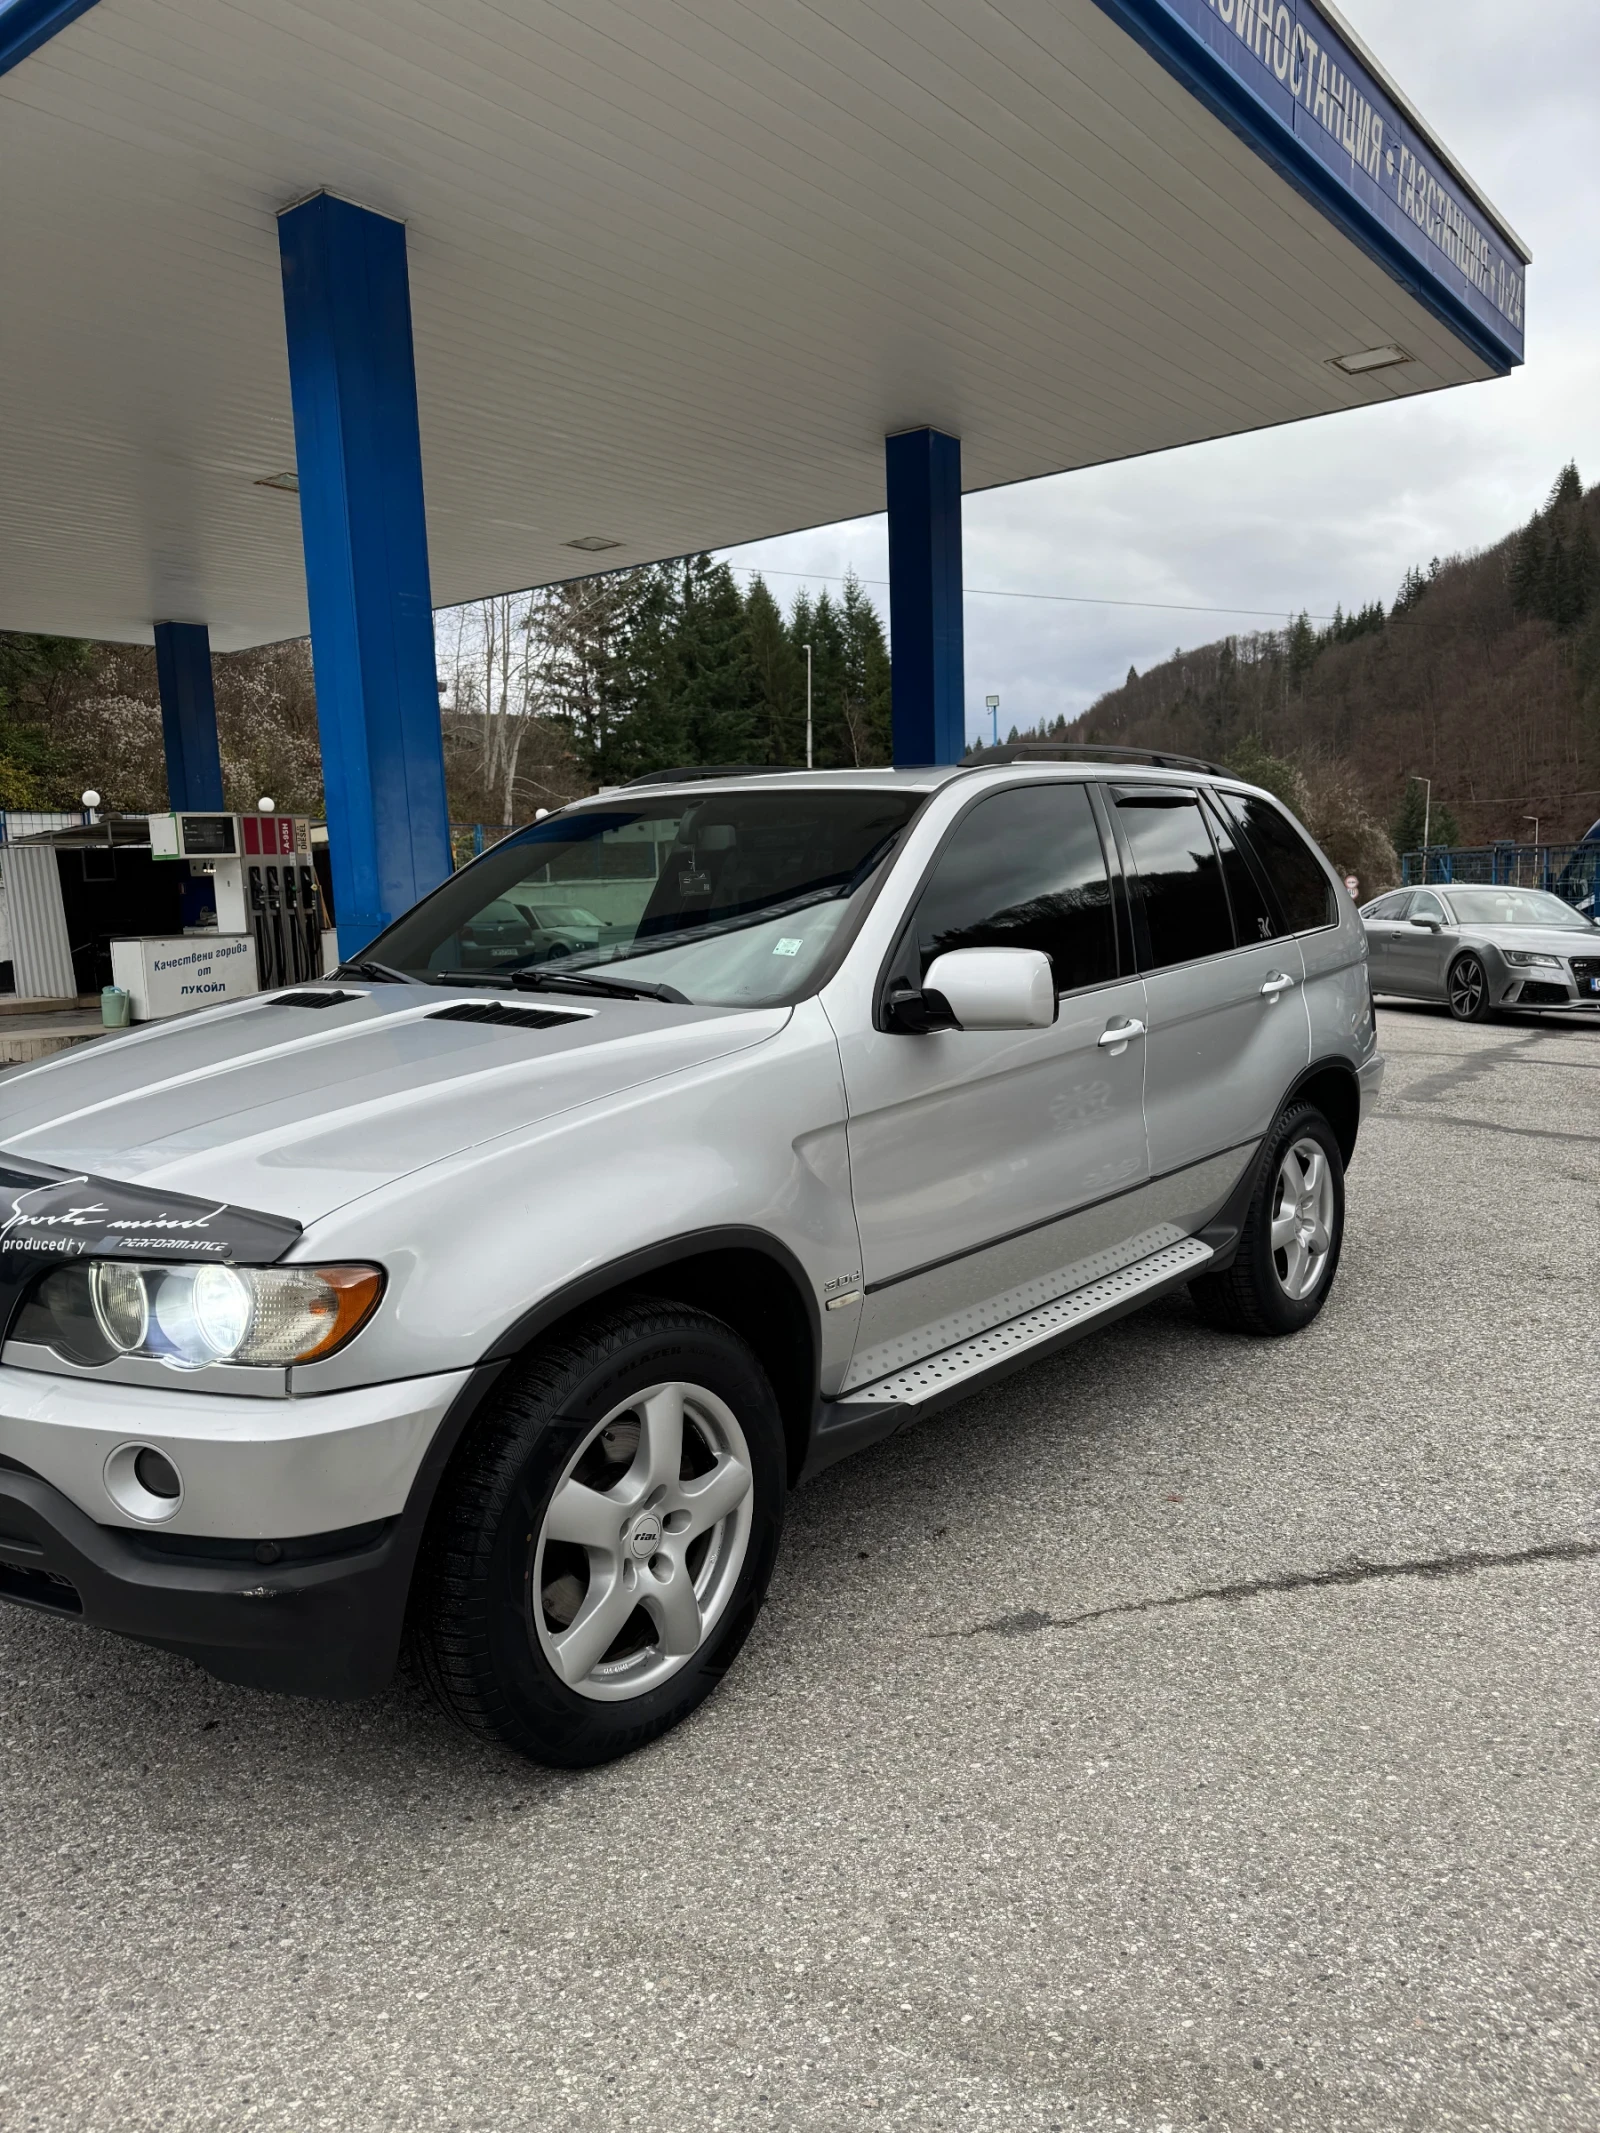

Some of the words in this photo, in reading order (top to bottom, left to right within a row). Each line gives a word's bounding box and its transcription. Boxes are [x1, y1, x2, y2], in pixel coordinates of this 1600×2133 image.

[1209, 0, 1383, 181] ИНОСТАНЦИЯ
[1398, 144, 1489, 293] ГАЗСТАНЦИЯ
[1498, 259, 1522, 328] 0-24
[299, 823, 308, 850] DIESEL
[154, 951, 213, 972] Качествени
[215, 943, 248, 958] горива
[197, 966, 212, 977] от
[181, 982, 226, 995] ЛУКОЙЛ
[119, 1238, 229, 1251] PERFORMANCE
[617, 1346, 683, 1378] BLAZER
